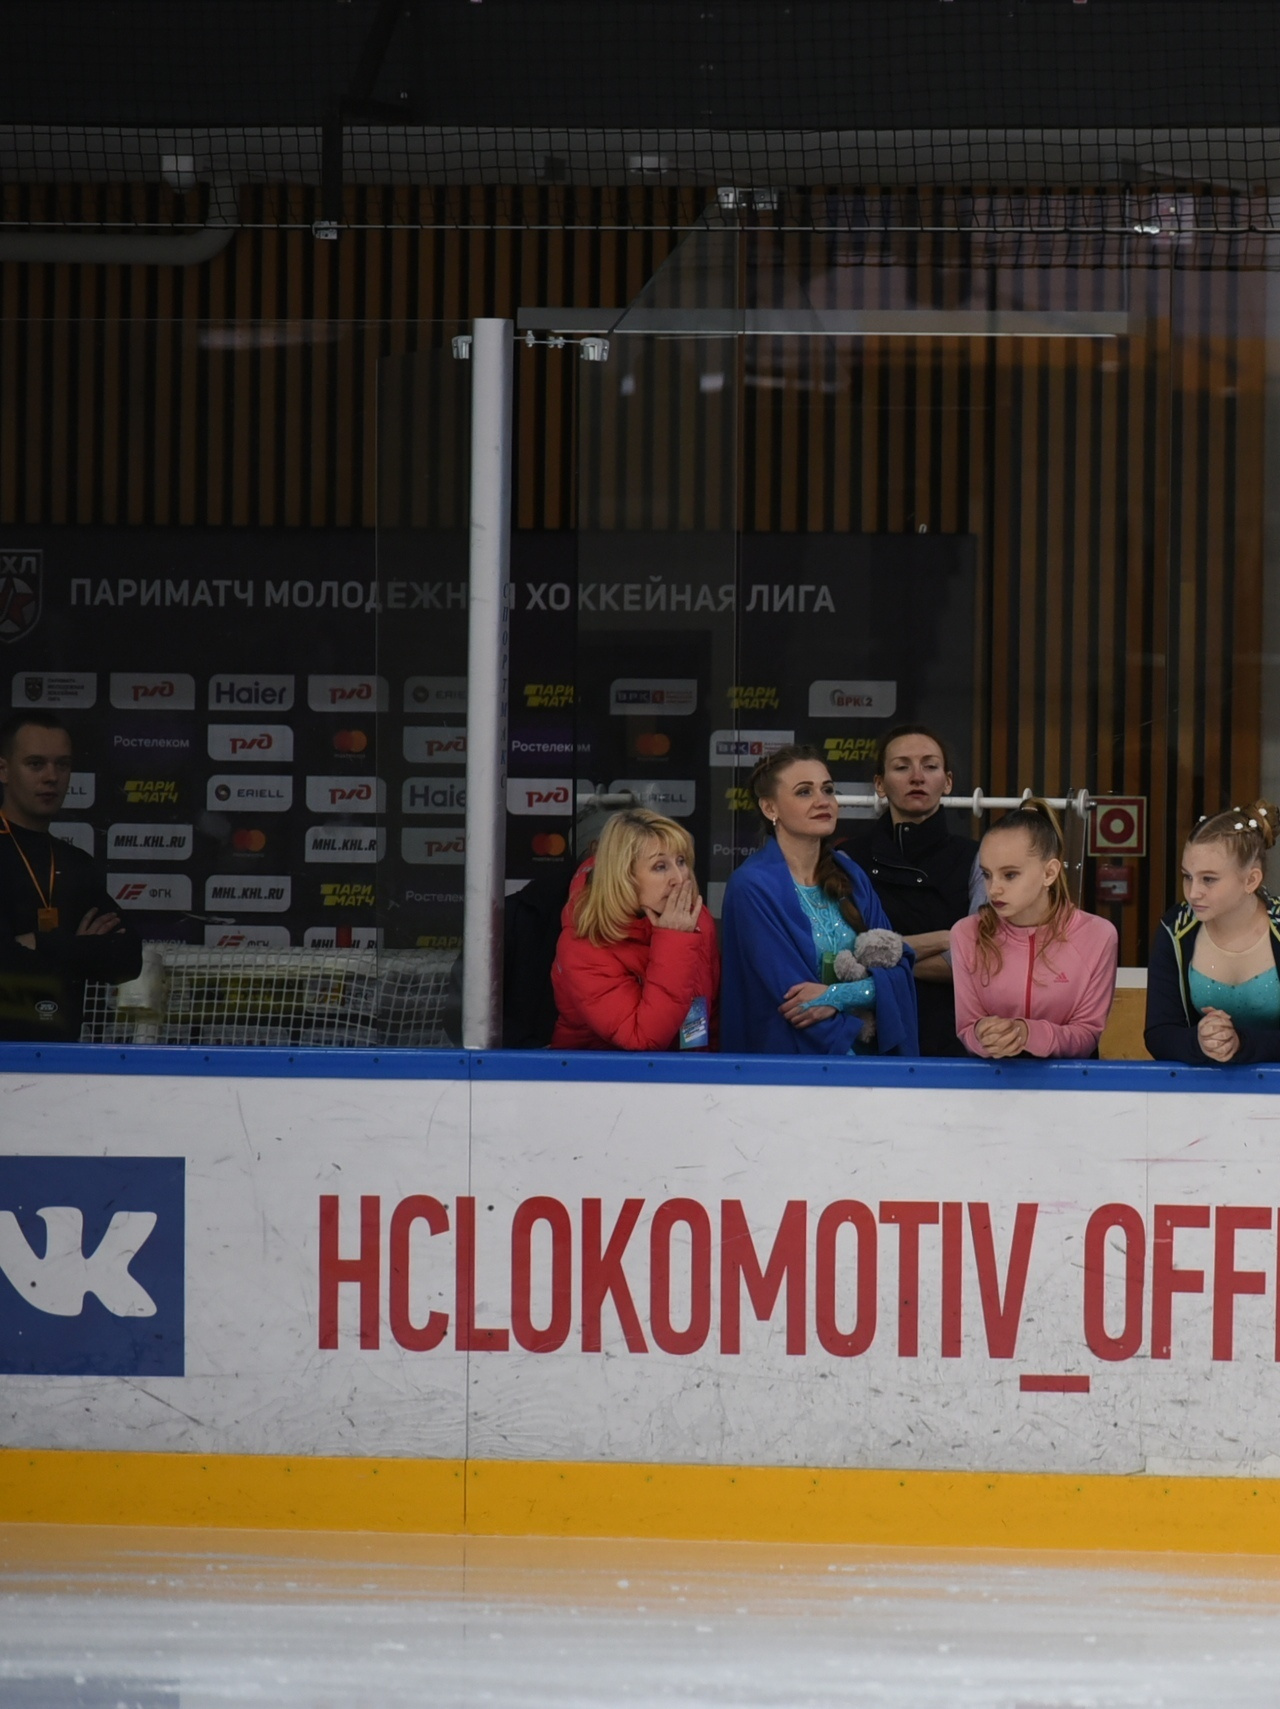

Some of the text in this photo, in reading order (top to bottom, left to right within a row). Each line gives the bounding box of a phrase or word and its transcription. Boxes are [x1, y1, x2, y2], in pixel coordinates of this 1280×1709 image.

[0, 556, 37, 574] ХЛ
[71, 578, 254, 608] ПАРИМАТЧ
[526, 575, 736, 612] ХОККЕЙНАЯ
[746, 584, 837, 612] ЛИГА
[215, 682, 286, 705] Haier
[113, 736, 190, 749] Ростелеком
[132, 780, 176, 792] ПАРИ
[136, 791, 178, 803] МАТЧ
[237, 789, 285, 799] ERIELL
[410, 784, 466, 808] Haie
[113, 835, 186, 848] MHL.KHL.RU
[149, 888, 172, 899] ФГК
[211, 887, 284, 900] MHL.KHL.RU
[329, 883, 373, 895] ПАРИ
